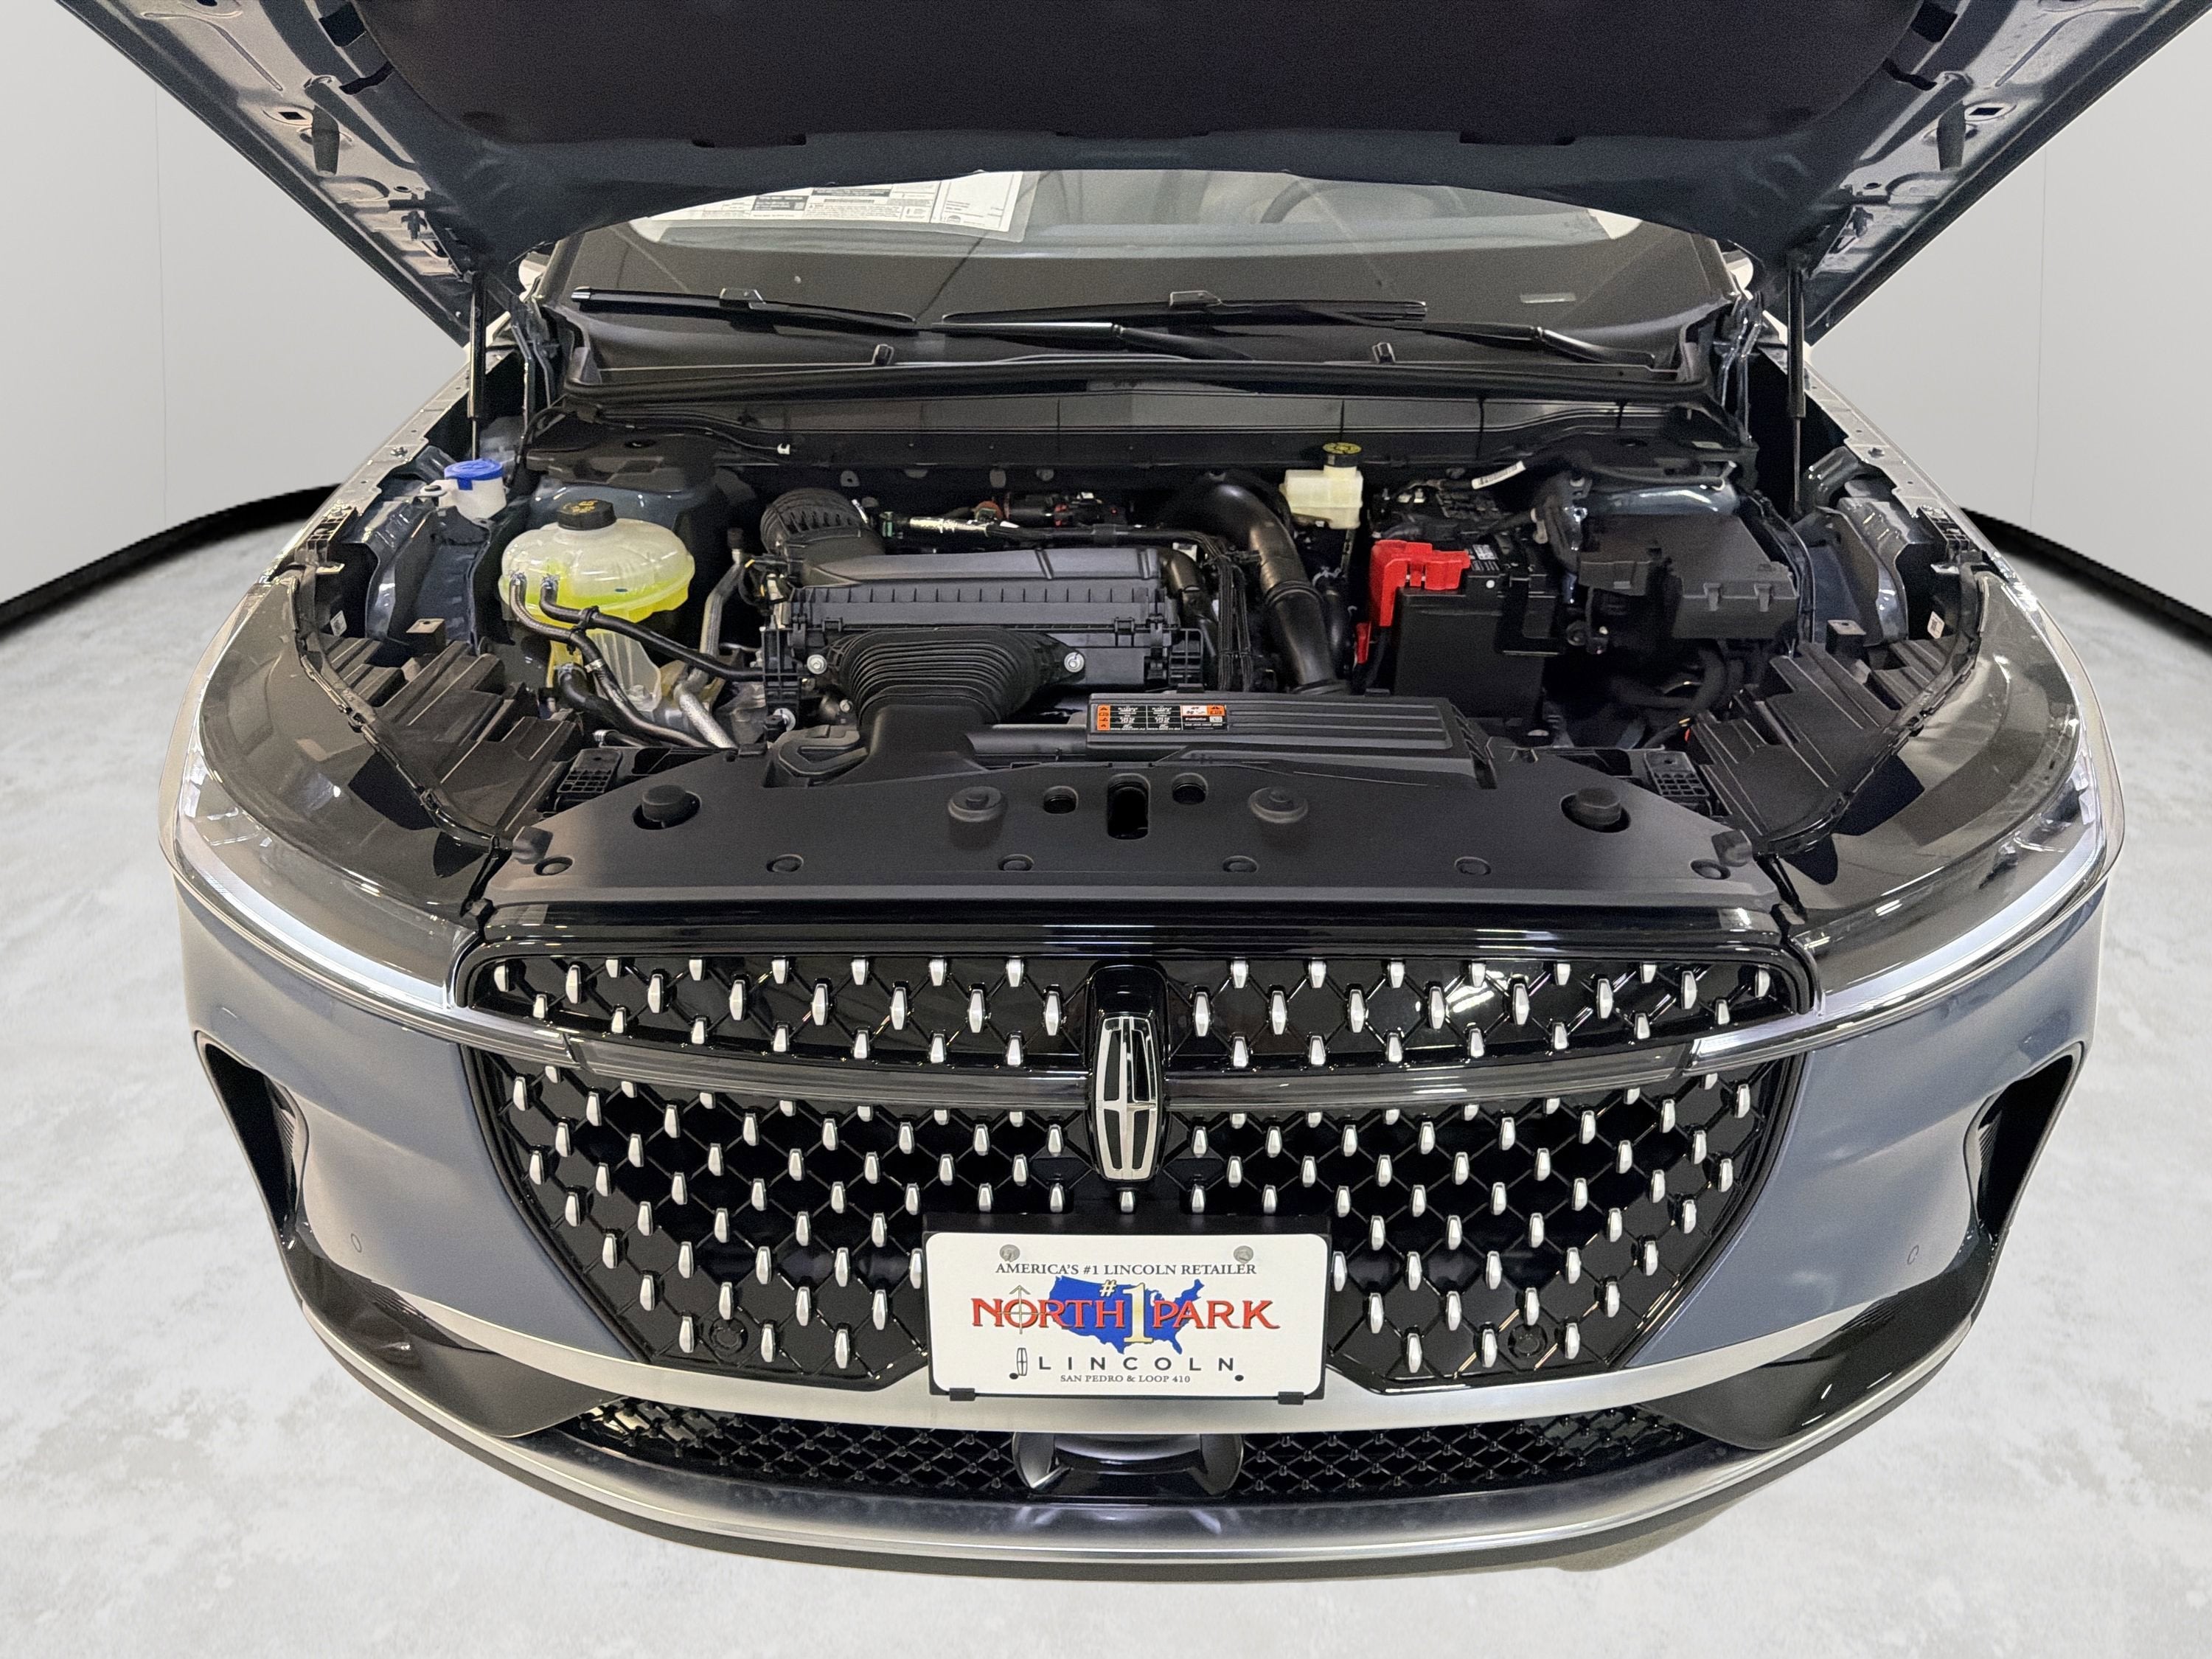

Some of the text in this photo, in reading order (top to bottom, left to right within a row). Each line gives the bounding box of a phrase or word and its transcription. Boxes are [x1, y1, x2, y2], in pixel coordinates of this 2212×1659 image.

[995, 1263, 1257, 1275] AMERICA'S #1 LINCOLN RETAILER
[970, 1298, 1281, 1329] NORTH PARK
[1038, 1356, 1234, 1371] LINCOLN
[1138, 1375, 1169, 1383] LOOP
[1172, 1375, 1191, 1383] 410
